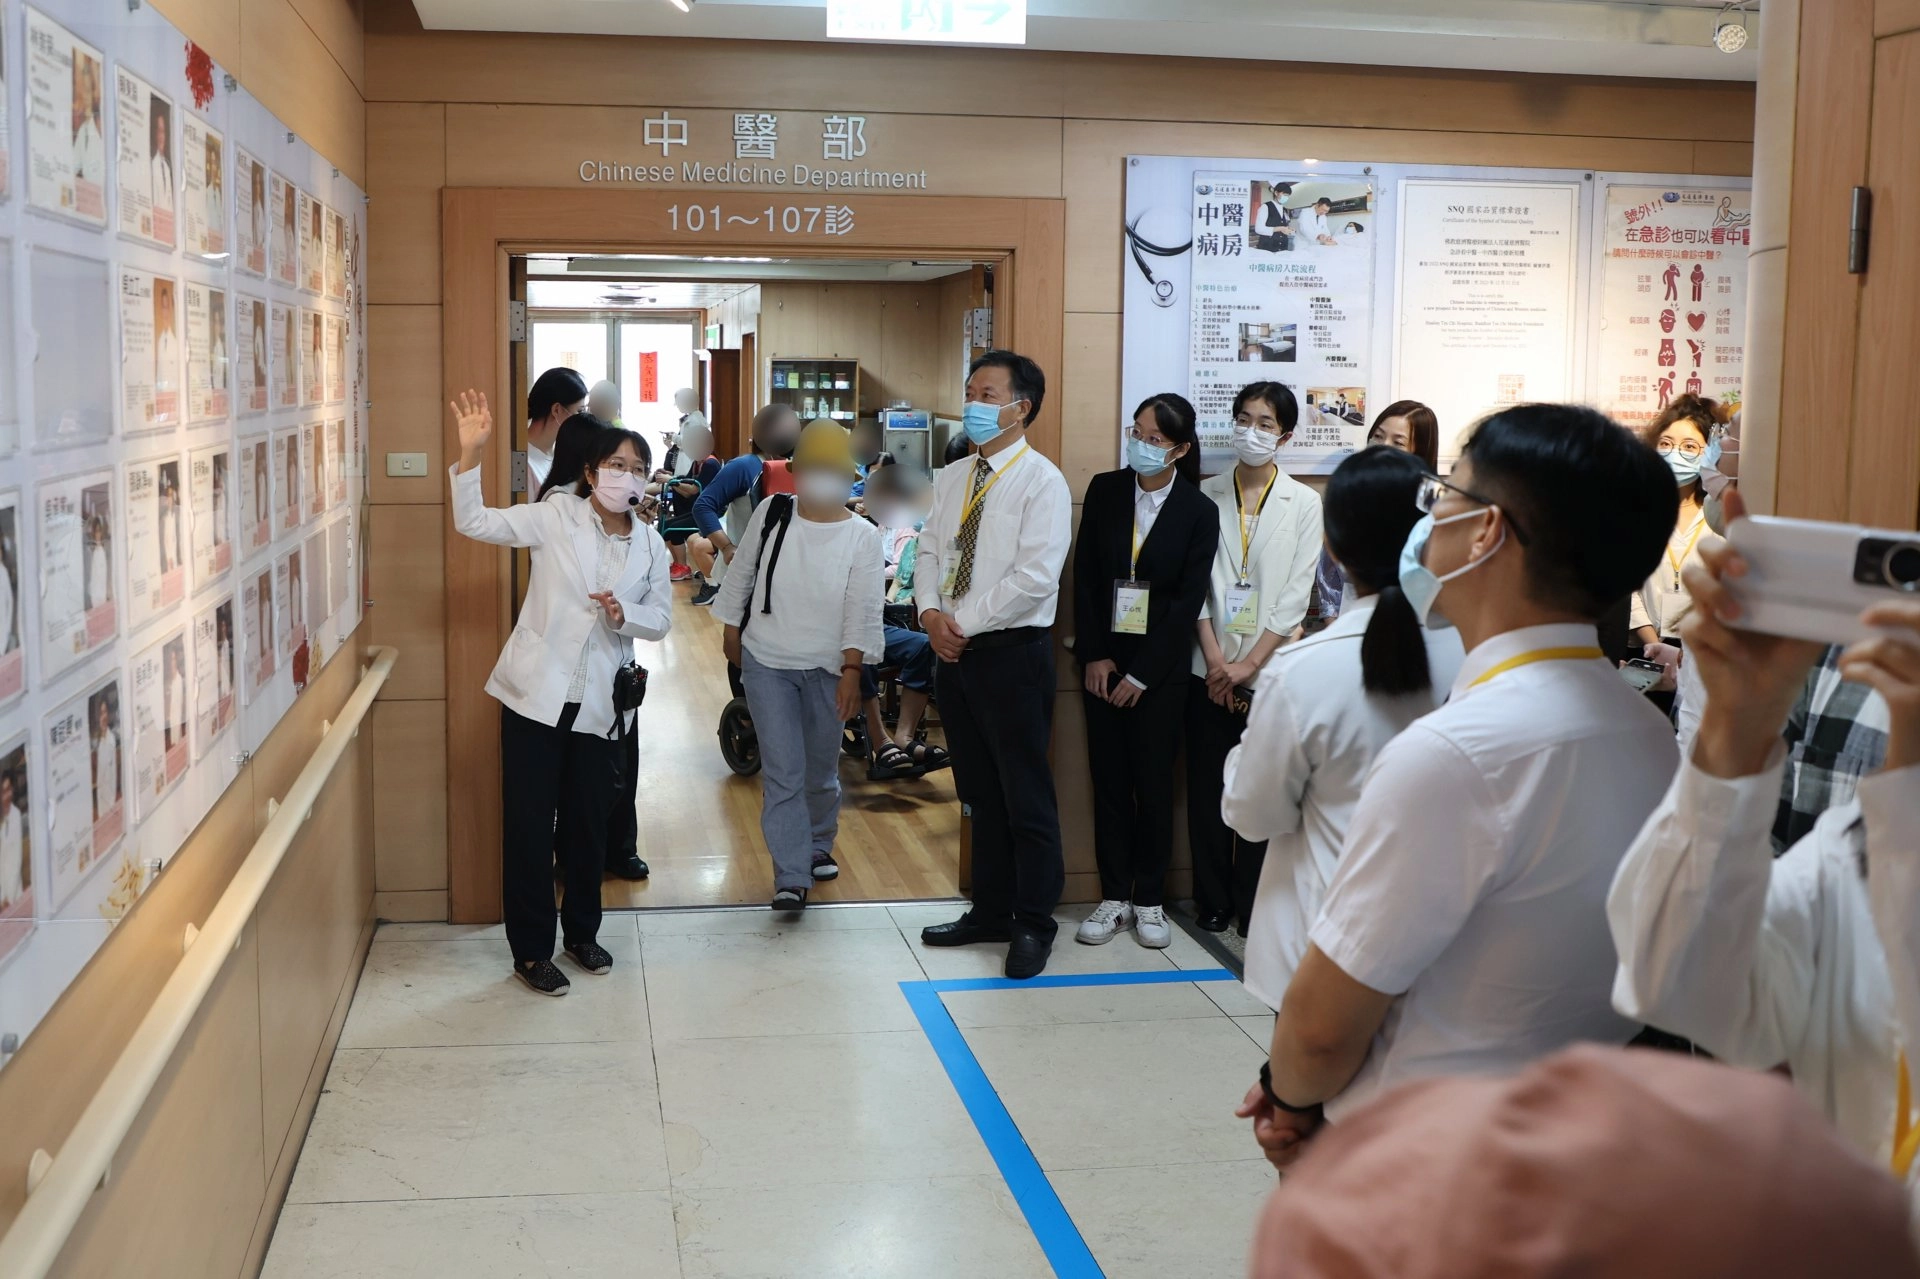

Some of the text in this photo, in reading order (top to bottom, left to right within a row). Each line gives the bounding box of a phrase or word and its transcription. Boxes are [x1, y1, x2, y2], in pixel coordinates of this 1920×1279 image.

[643, 112, 868, 161] 中醫部
[579, 160, 927, 190] Chinese Medicine Department
[1198, 202, 1244, 227] 中醫
[1448, 205, 1465, 214] SNQ
[1198, 232, 1242, 256] 病房
[1249, 264, 1317, 274] 中醫病房入院流程
